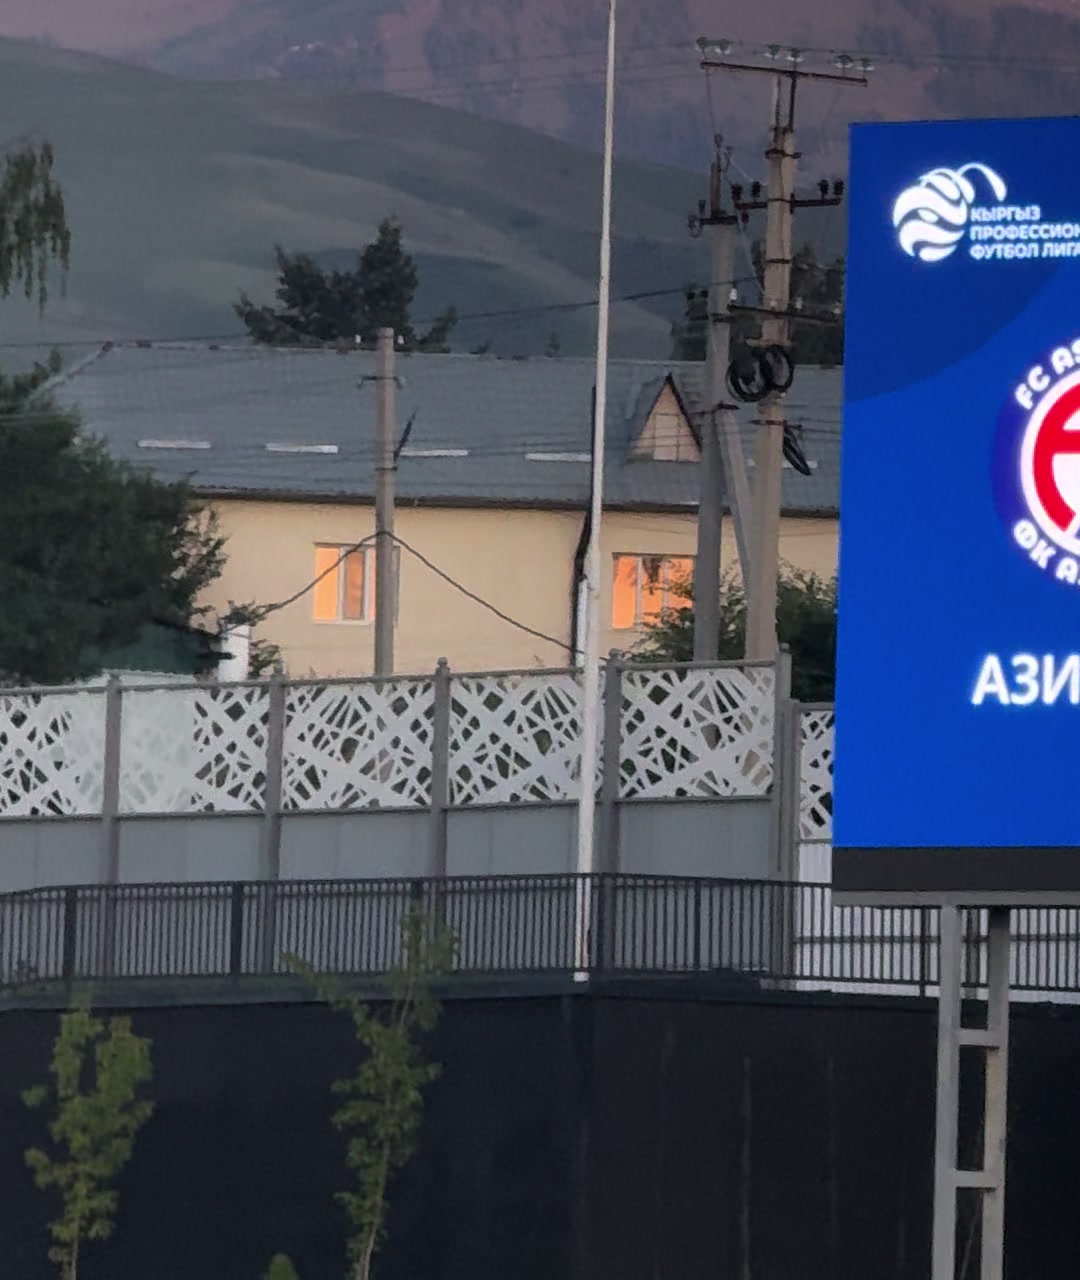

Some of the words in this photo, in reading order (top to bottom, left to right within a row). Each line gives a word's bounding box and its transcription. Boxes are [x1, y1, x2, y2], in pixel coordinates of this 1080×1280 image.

[970, 205, 1041, 222] КЫРГЫЗ
[969, 243, 1040, 260] ФУТБОЛ
[1014, 365, 1051, 410] FC
[1013, 518, 1056, 569] ФК
